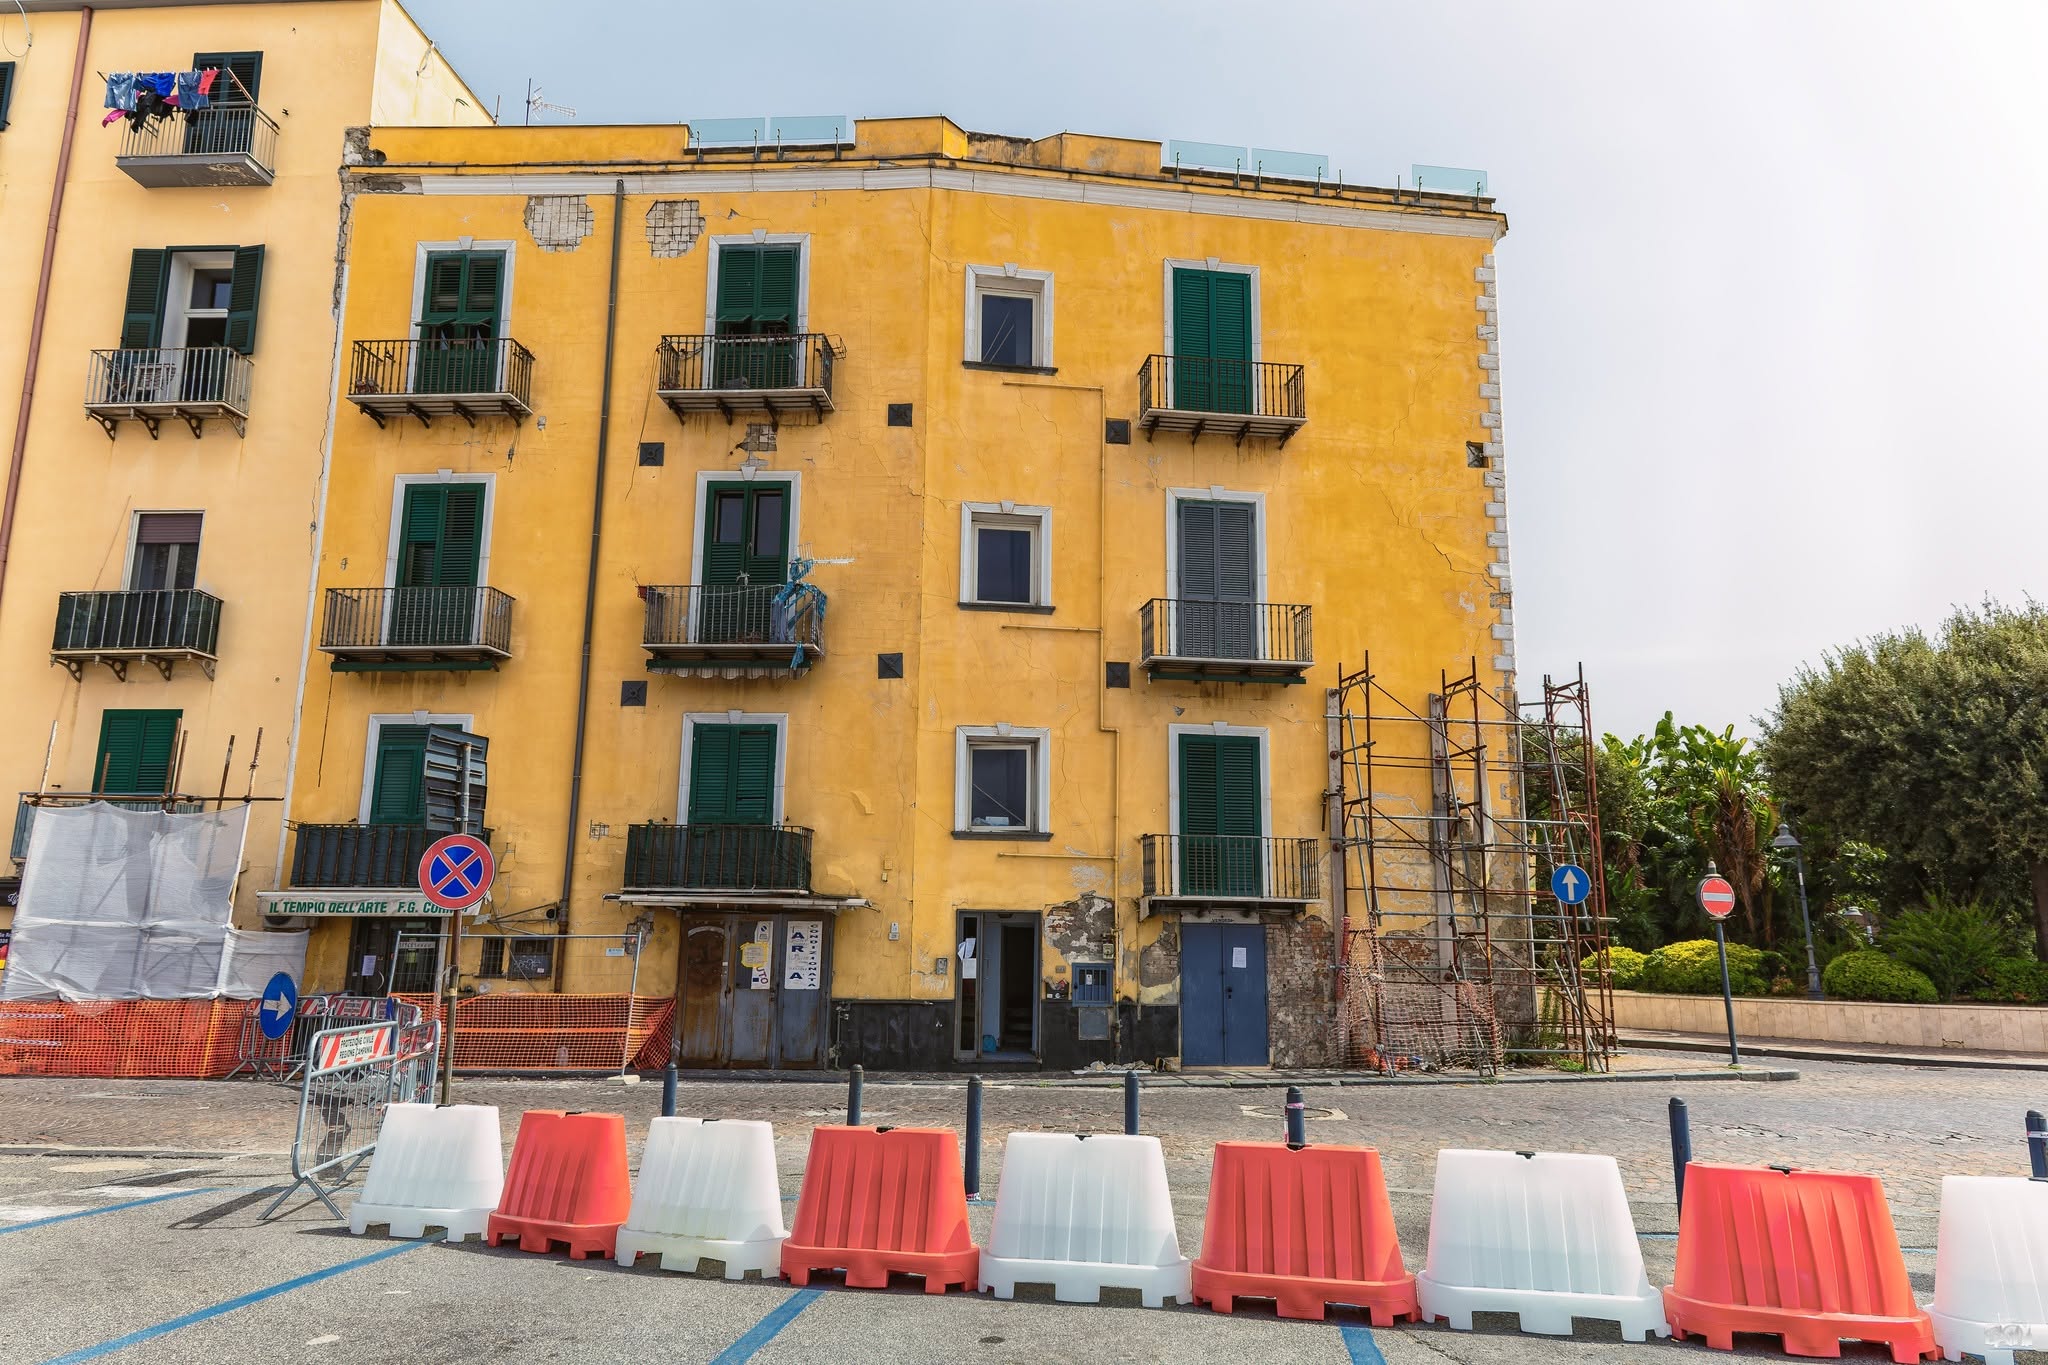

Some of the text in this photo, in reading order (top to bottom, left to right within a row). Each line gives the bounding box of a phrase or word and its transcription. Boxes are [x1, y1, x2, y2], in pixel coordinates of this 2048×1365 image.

[269, 902, 280, 913] IL
[283, 902, 325, 913] TEMPIO
[328, 902, 388, 913] DELL'ARTE
[397, 902, 418, 913] F.G.
